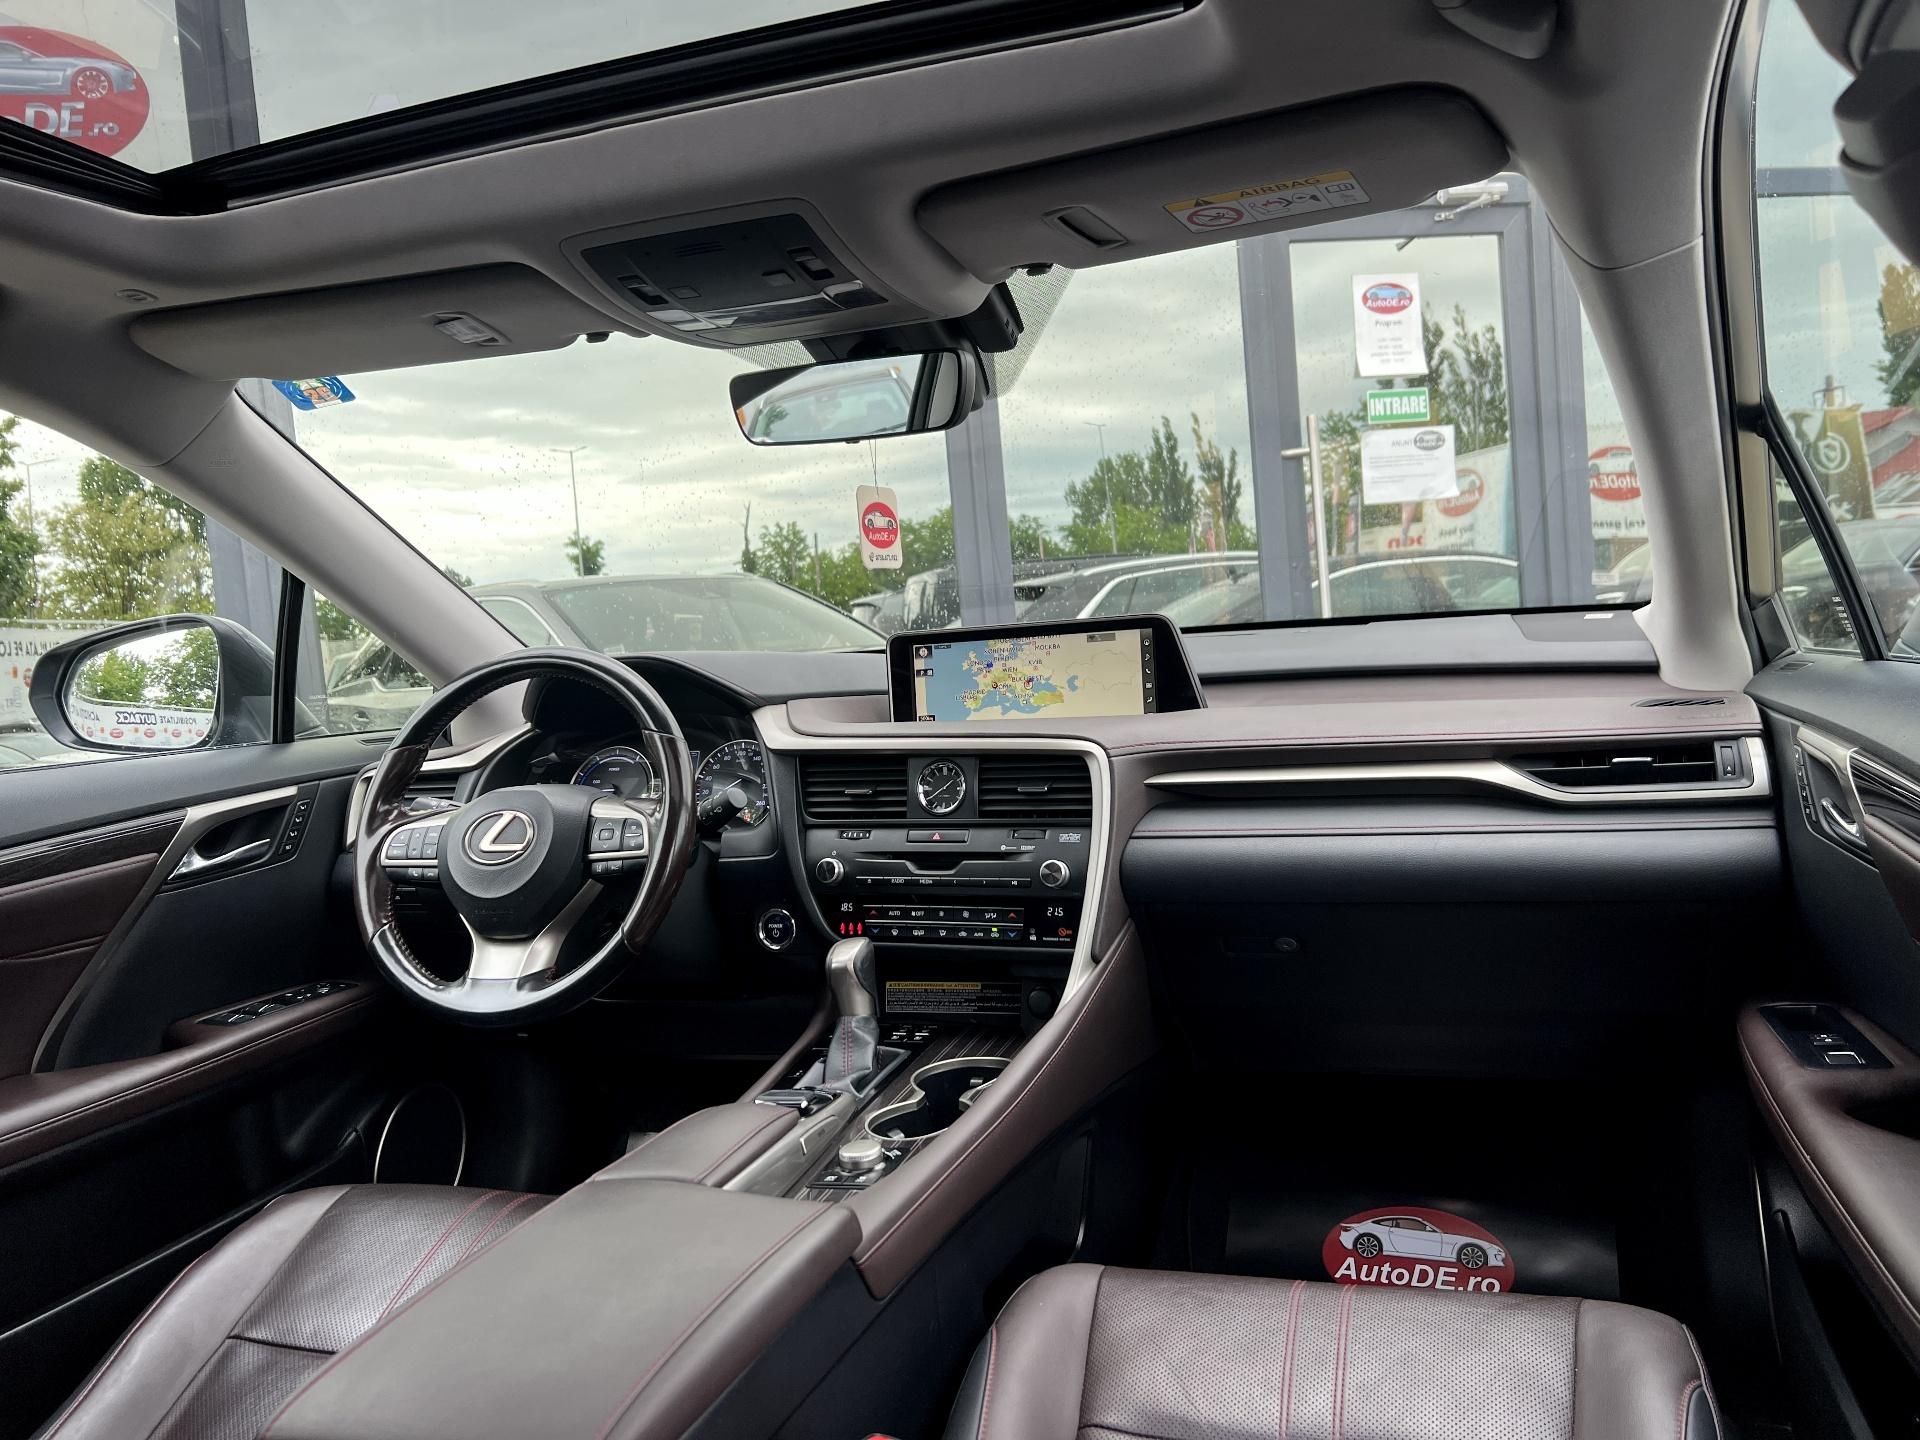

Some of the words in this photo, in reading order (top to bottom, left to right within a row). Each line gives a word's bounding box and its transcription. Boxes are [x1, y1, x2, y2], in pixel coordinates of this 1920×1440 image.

[2, 101, 119, 137] DE.ro
[1239, 177, 1321, 198] AIRBAG
[1366, 298, 1410, 308] AutoDE.ro
[1370, 395, 1427, 416] INTRARE
[868, 531, 896, 541] AutoDE.ro
[1335, 1256, 1501, 1293] AutoDE.ro
